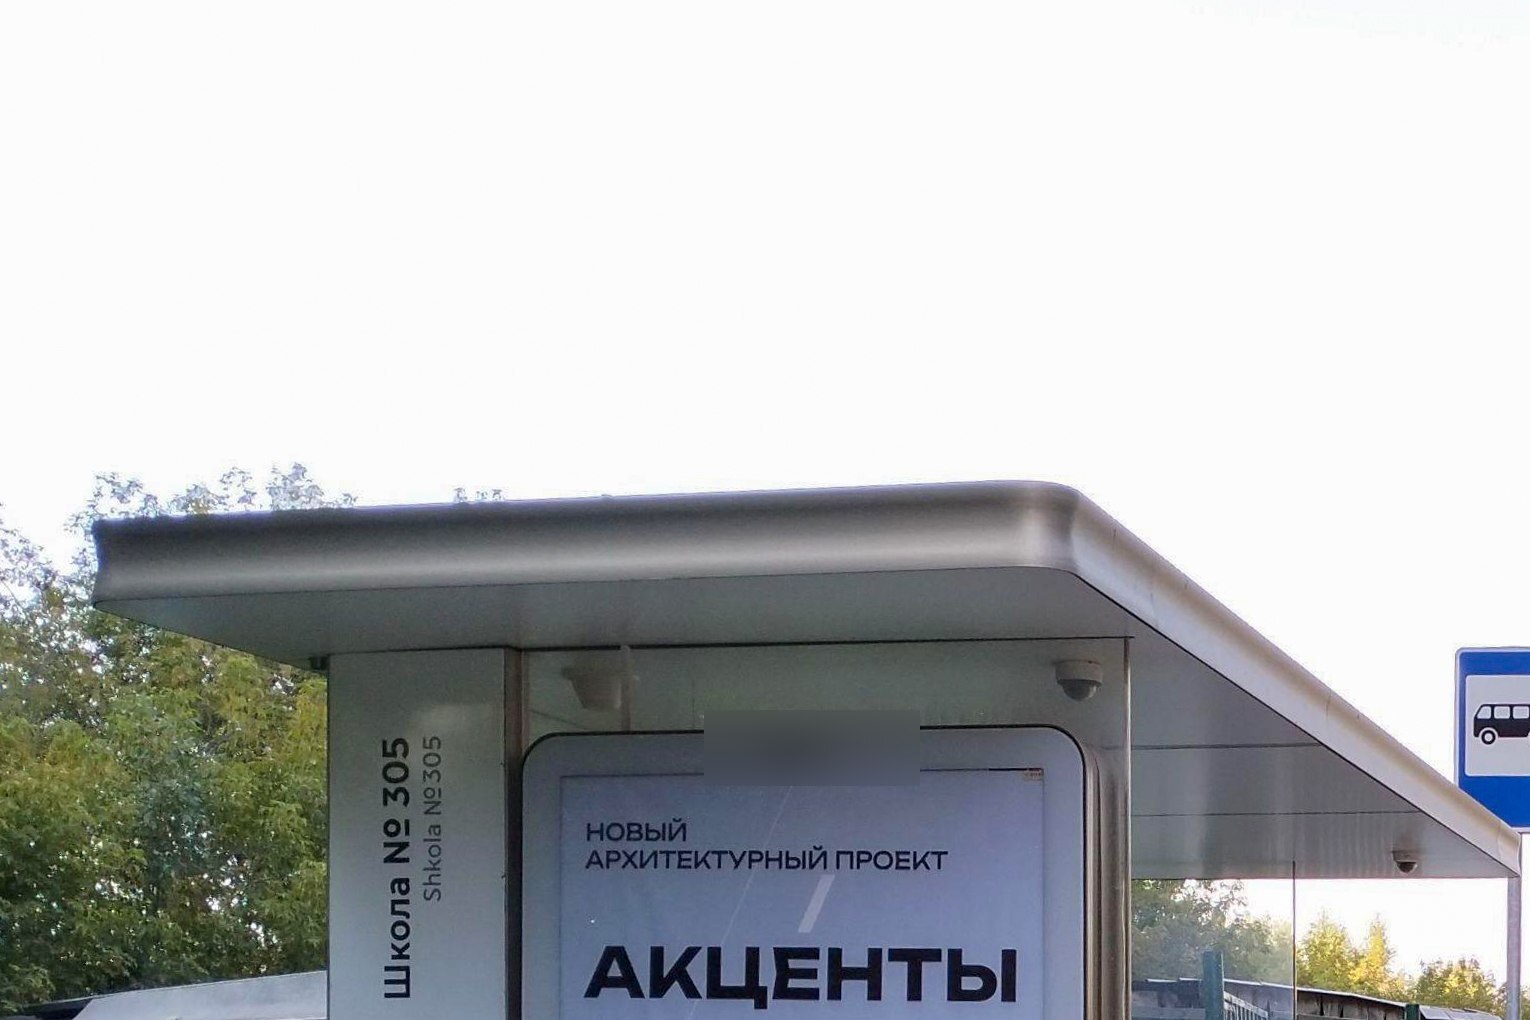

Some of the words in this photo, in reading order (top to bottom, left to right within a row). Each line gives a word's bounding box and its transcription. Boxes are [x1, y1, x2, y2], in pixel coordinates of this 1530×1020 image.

[382, 737, 410, 807] 305
[422, 824, 442, 902] Shkola
[585, 818, 688, 842] НОВЫЙ
[585, 846, 828, 870] АРХИТЕКТУРНЫЙ
[835, 850, 949, 871] ПРОЕКТ
[384, 877, 411, 998] Школа
[583, 945, 1017, 1009] АКЦЕНТЫ
